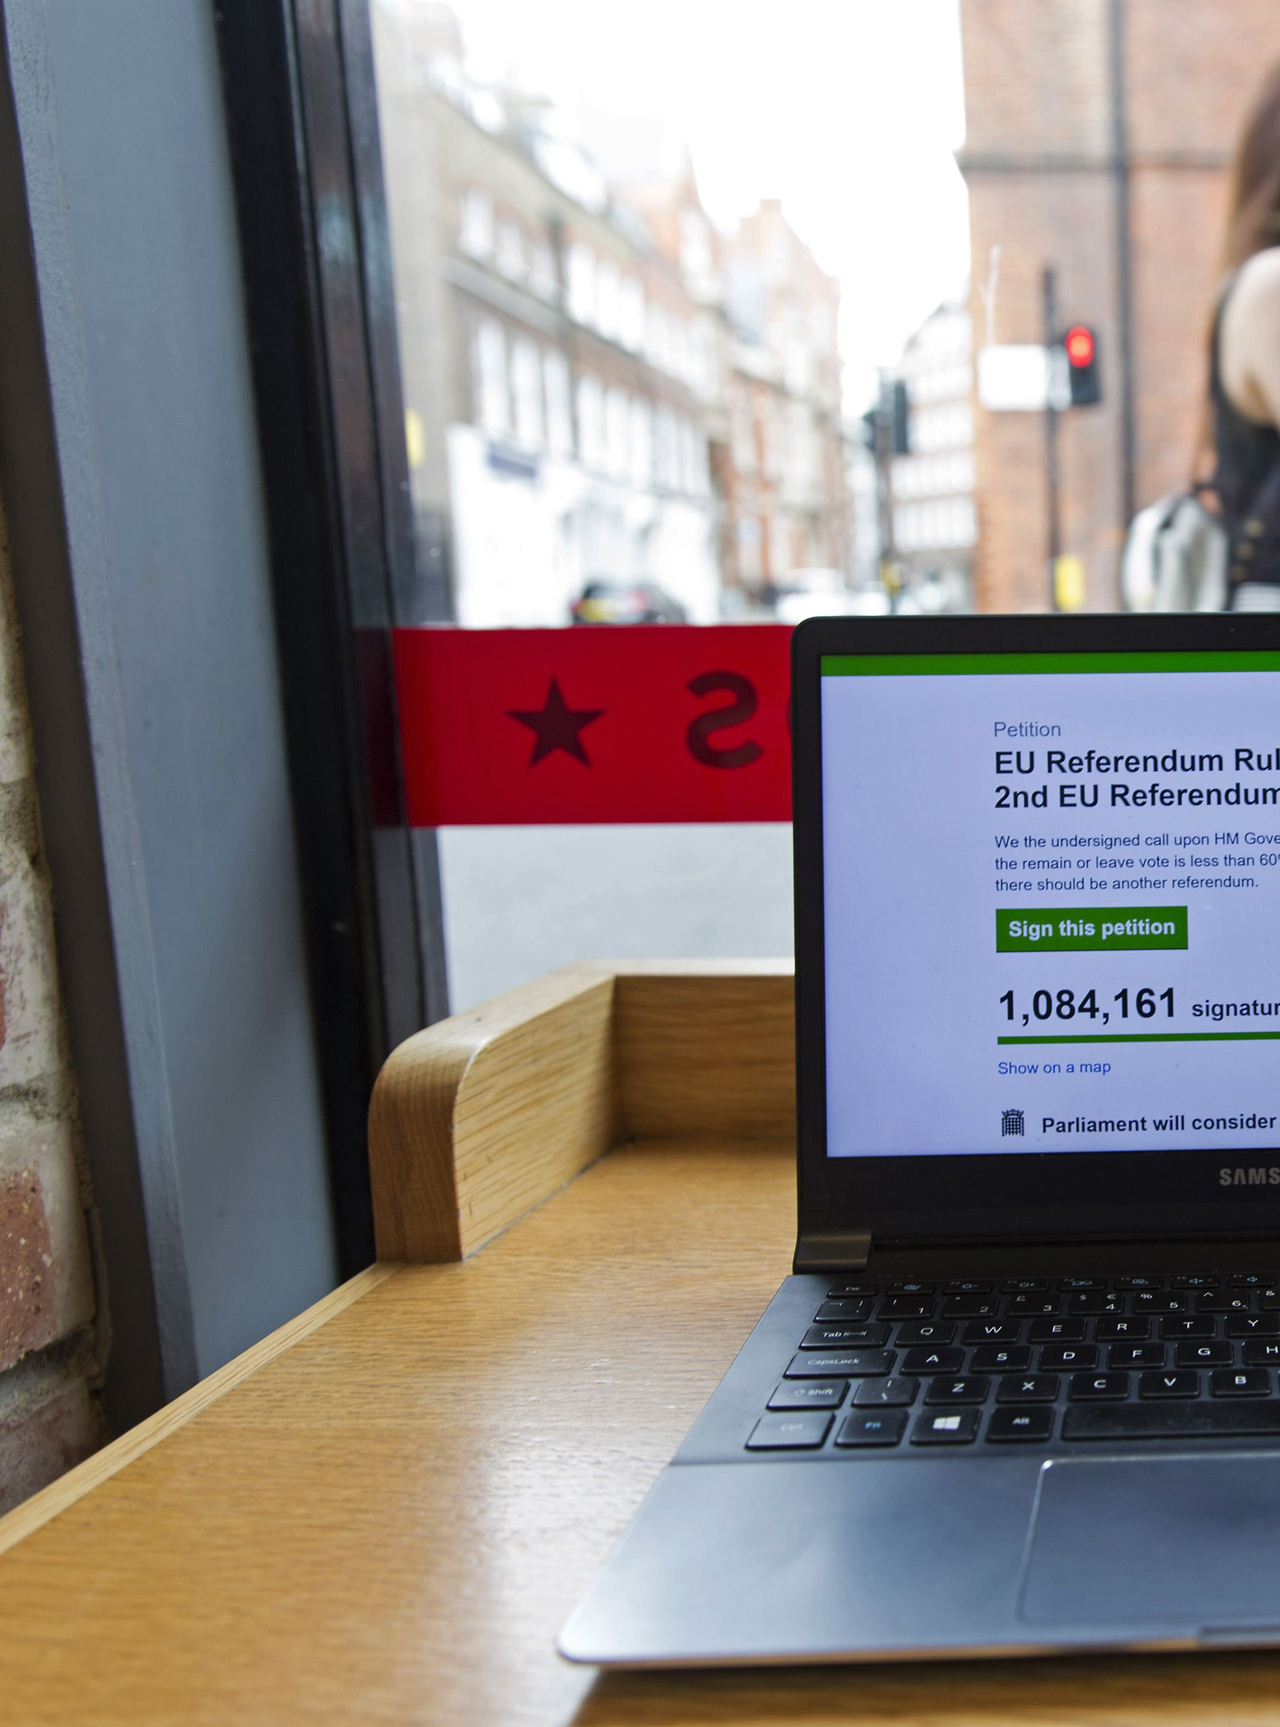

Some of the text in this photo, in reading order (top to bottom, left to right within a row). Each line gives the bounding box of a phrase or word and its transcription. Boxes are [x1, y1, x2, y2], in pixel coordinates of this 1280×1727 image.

[994, 721, 1061, 737] Petition
[996, 751, 1034, 774] EU
[1047, 749, 1223, 773] Referendum
[995, 785, 1047, 808] 2nd
[1060, 785, 1098, 807] EU
[995, 836, 1019, 848] We
[1024, 836, 1046, 848] the
[1051, 834, 1139, 850] undersigned
[1145, 834, 1168, 846] call
[1174, 836, 1209, 848] upon
[1215, 832, 1239, 845] HM
[995, 858, 1017, 870] the
[1023, 857, 1071, 869] remain
[1077, 859, 1091, 868] or
[1096, 856, 1134, 868] leave
[1139, 856, 1169, 867] vote
[1175, 855, 1185, 867] is
[1191, 855, 1219, 867] less
[1224, 854, 1254, 866] than
[995, 875, 1258, 891] there should be another referendum.
[1009, 919, 1175, 941] Sign this petition
[1000, 988, 1174, 1026] 1,084,161
[998, 1062, 1111, 1075] Show on a map
[1043, 1117, 1147, 1133] Parliament
[1153, 1115, 1184, 1131] will
[1192, 1114, 1277, 1130] consider
[1043, 1304, 1052, 1312] 3
[1116, 1323, 1128, 1331] R
[1183, 1321, 1194, 1329] T
[1247, 1319, 1259, 1327] Y
[920, 1327, 934, 1336] Q
[984, 1326, 1003, 1334] W
[1051, 1324, 1062, 1333] E
[1132, 1349, 1142, 1358] F
[1197, 1347, 1211, 1356] G
[1266, 1345, 1279, 1354] H
[925, 1354, 939, 1363] A
[996, 1352, 1008, 1361] S
[1062, 1351, 1076, 1360] D
[807, 1357, 860, 1367] CapsLock
[1093, 1379, 1107, 1389] C
[1163, 1377, 1177, 1387] V
[1234, 1375, 1247, 1385] B
[951, 1382, 965, 1393] Z
[1022, 1381, 1035, 1391] X
[807, 1389, 832, 1397] Shift
[864, 1421, 881, 1429] Fn
[1012, 1417, 1030, 1425] Alt
